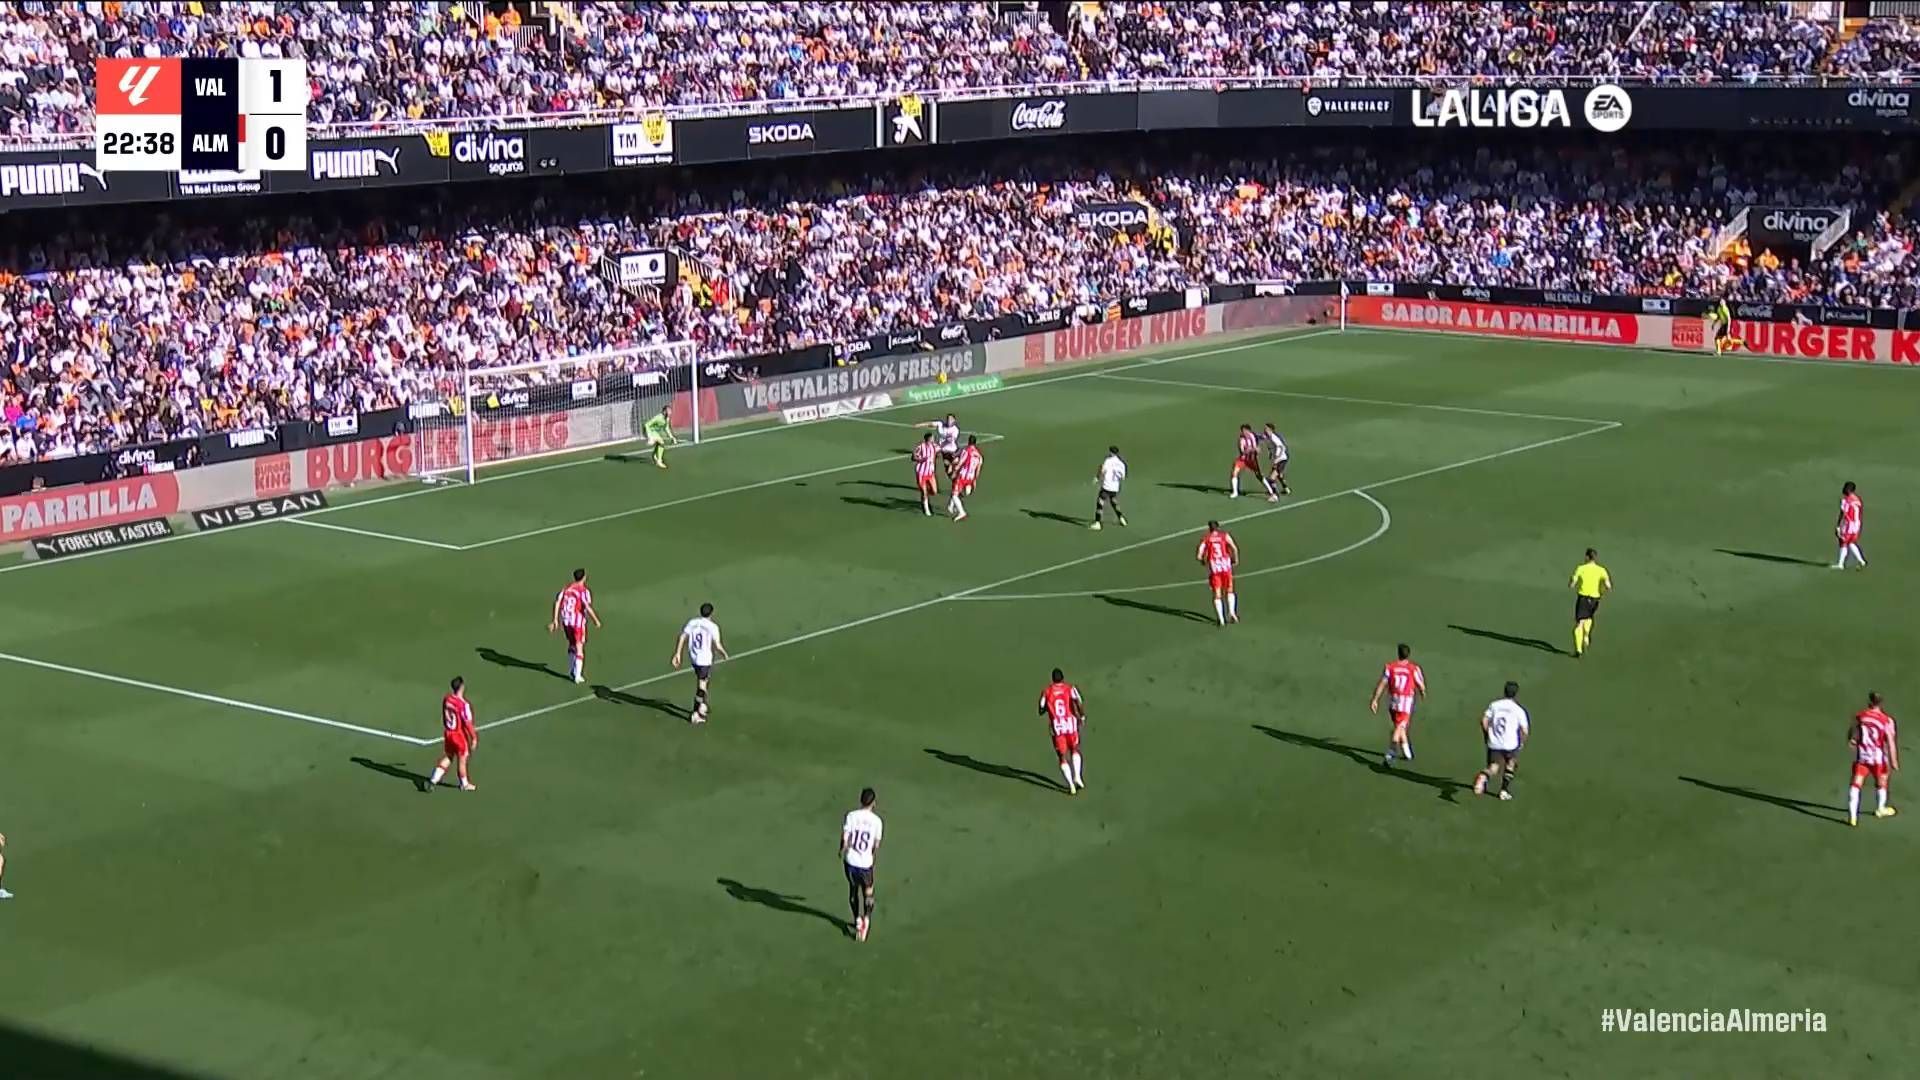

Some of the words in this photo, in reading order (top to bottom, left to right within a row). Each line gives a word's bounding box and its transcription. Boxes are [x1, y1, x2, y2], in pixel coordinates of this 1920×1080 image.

[1848, 88, 1910, 107] divina
[455, 132, 524, 163] divina
[618, 133, 637, 148] TM
[1, 163, 80, 197] PUMA
[313, 149, 377, 180] PUMA
[489, 161, 524, 176] seguros
[237, 182, 261, 193] Group
[1763, 211, 1829, 231] divina
[1054, 318, 1143, 361] BURGER
[1149, 307, 1207, 346] KING
[1382, 302, 1453, 324] SABOR
[1456, 308, 1473, 327] A
[1476, 309, 1504, 329] LA
[1508, 311, 1622, 338] PARRILLA
[744, 368, 849, 409] VEGETALES
[852, 362, 896, 391] 100%
[899, 350, 973, 381] FRESCOS
[473, 411, 569, 464] KING
[256, 471, 291, 490] KING
[1, 483, 158, 533] PARRILLA
[201, 494, 321, 527] NISSAN
[58, 530, 120, 553] FOREVER.
[120, 520, 171, 542] FASTER.
[1055, 699, 1066, 717] 6
[853, 829, 870, 852] 18
